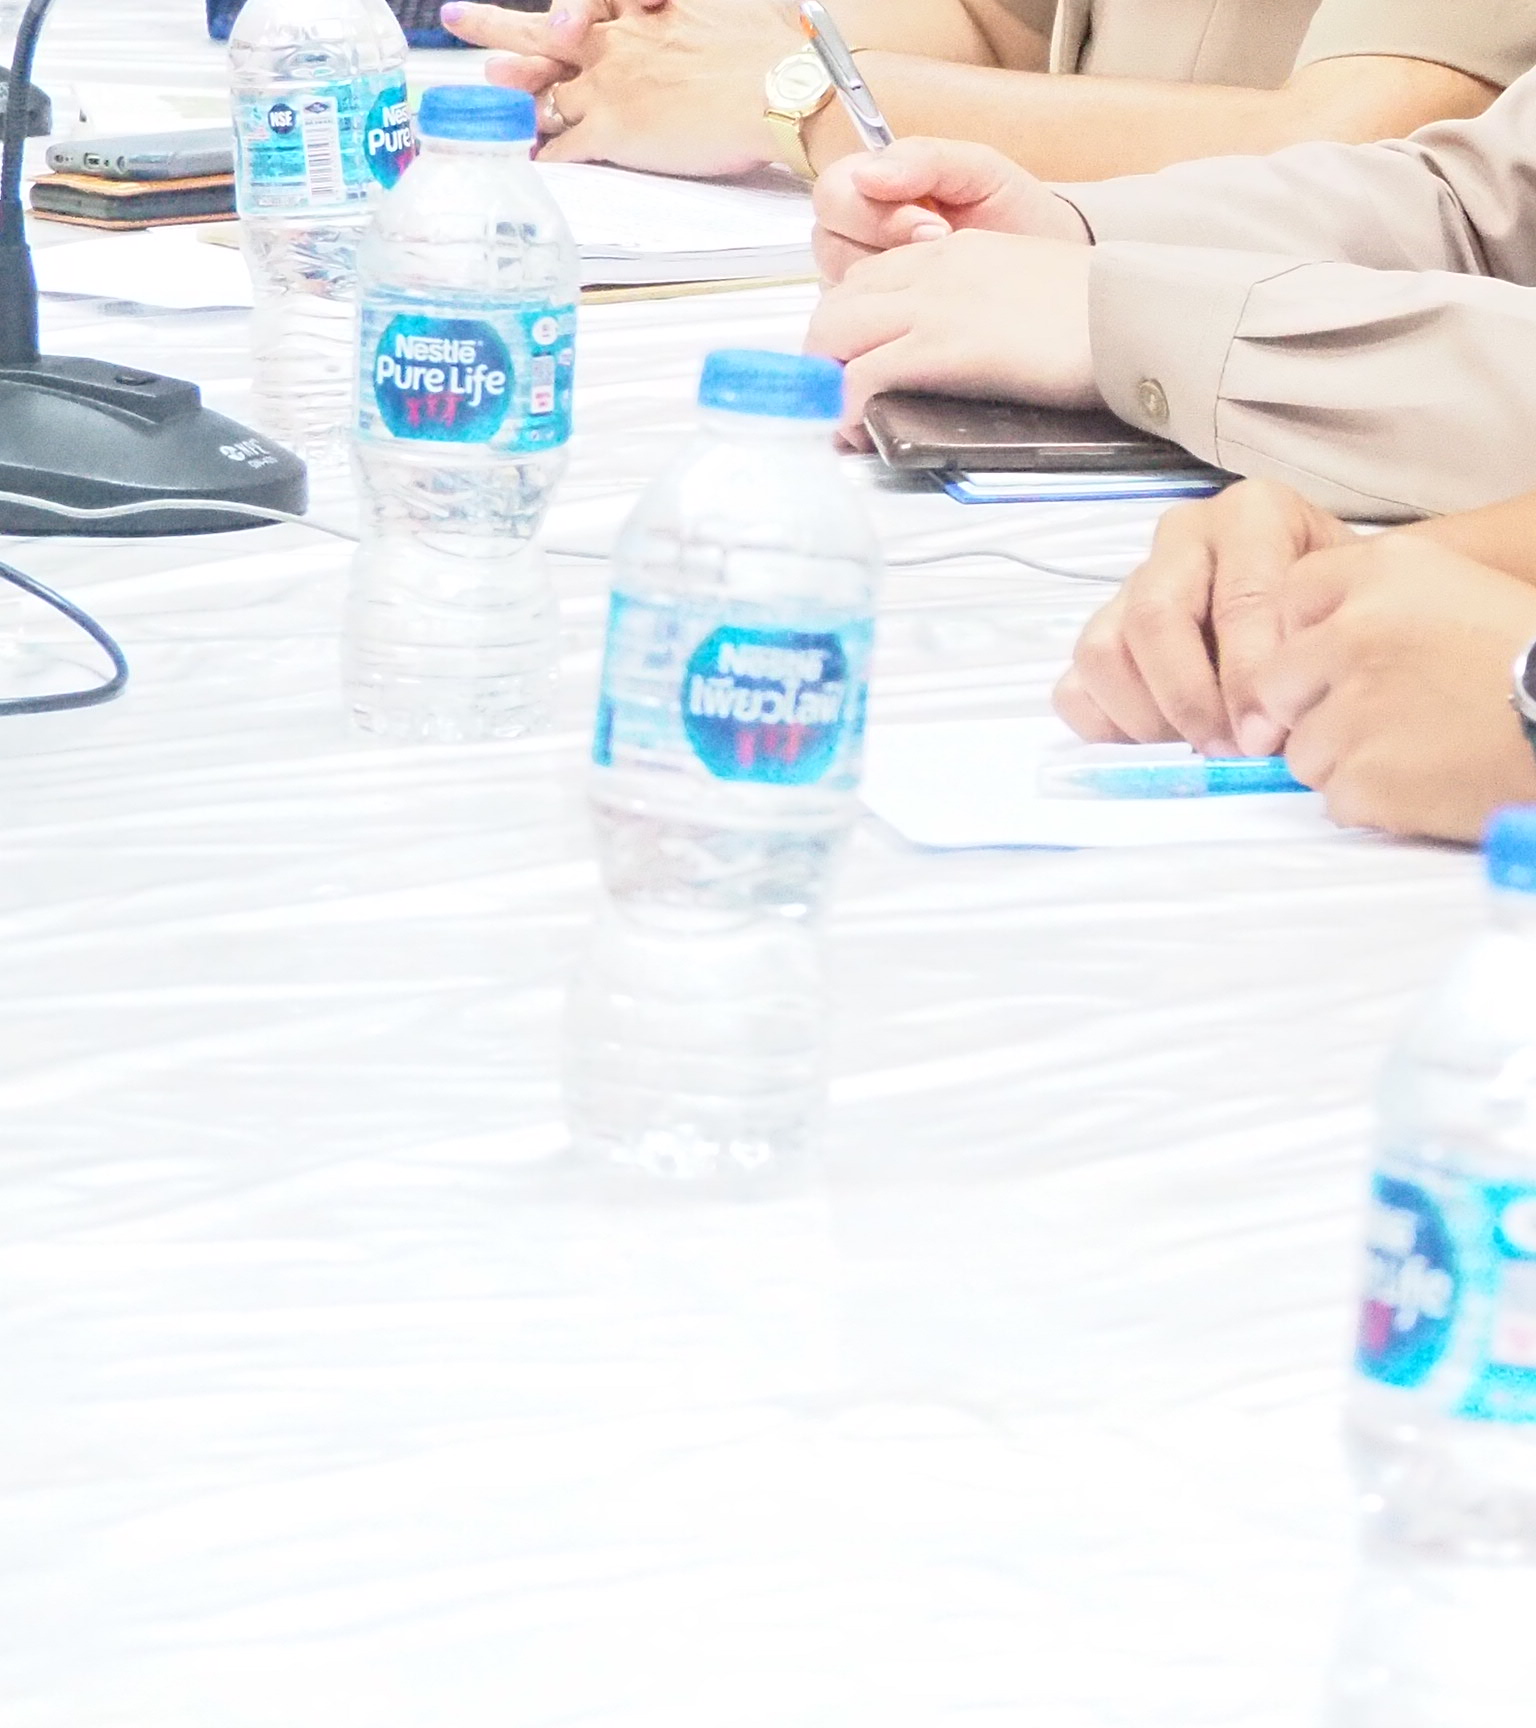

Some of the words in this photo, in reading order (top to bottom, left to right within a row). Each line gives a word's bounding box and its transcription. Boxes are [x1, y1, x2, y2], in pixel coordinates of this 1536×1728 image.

[367, 127, 412, 156] Pure
[376, 354, 446, 393] Pure
[449, 362, 508, 408] Life
